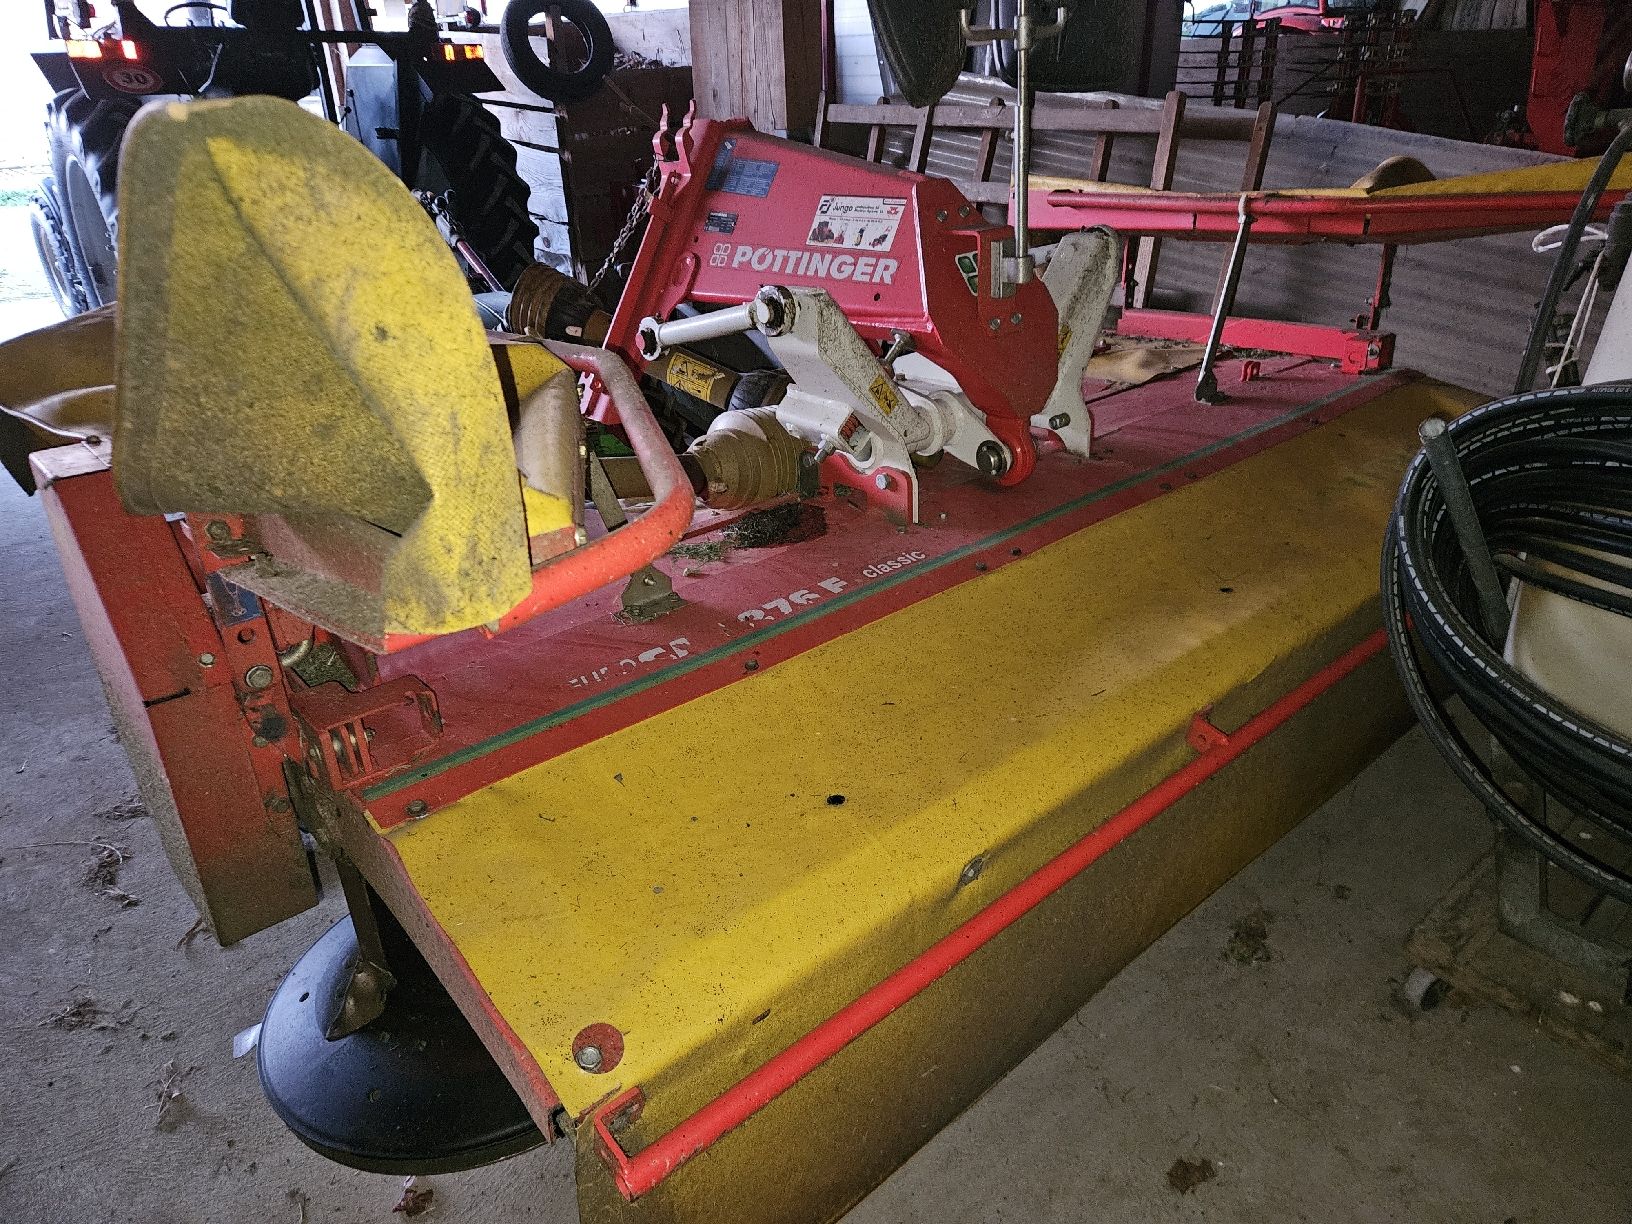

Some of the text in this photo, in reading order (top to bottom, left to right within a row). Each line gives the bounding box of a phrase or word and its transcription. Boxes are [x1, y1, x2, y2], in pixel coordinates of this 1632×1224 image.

[121, 72, 148, 85] 30
[817, 576, 849, 594] F
[862, 550, 926, 579] classic
